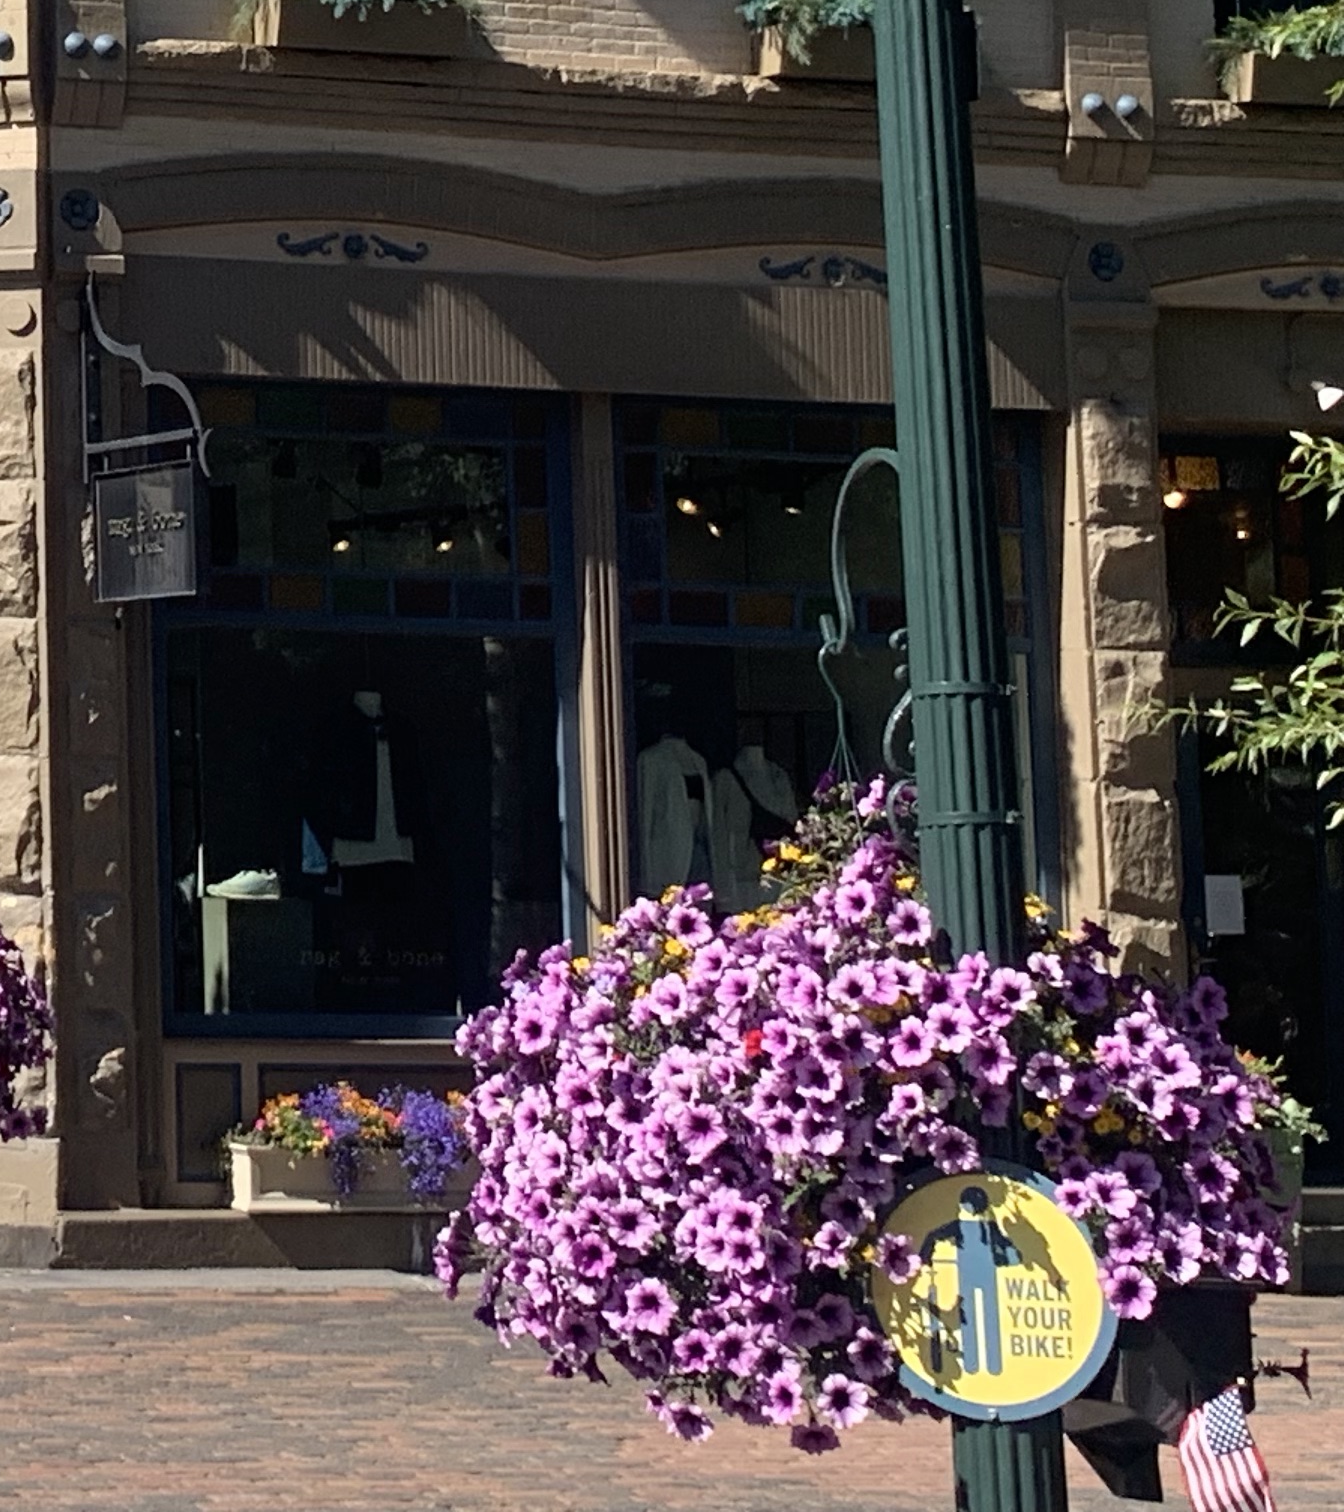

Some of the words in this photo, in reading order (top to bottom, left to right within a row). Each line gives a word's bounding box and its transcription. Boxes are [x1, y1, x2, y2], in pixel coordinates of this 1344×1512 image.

[1006, 1277, 1071, 1302] WALK
[1007, 1306, 1073, 1331] YOUR
[1011, 1334, 1074, 1360] BIKE!
